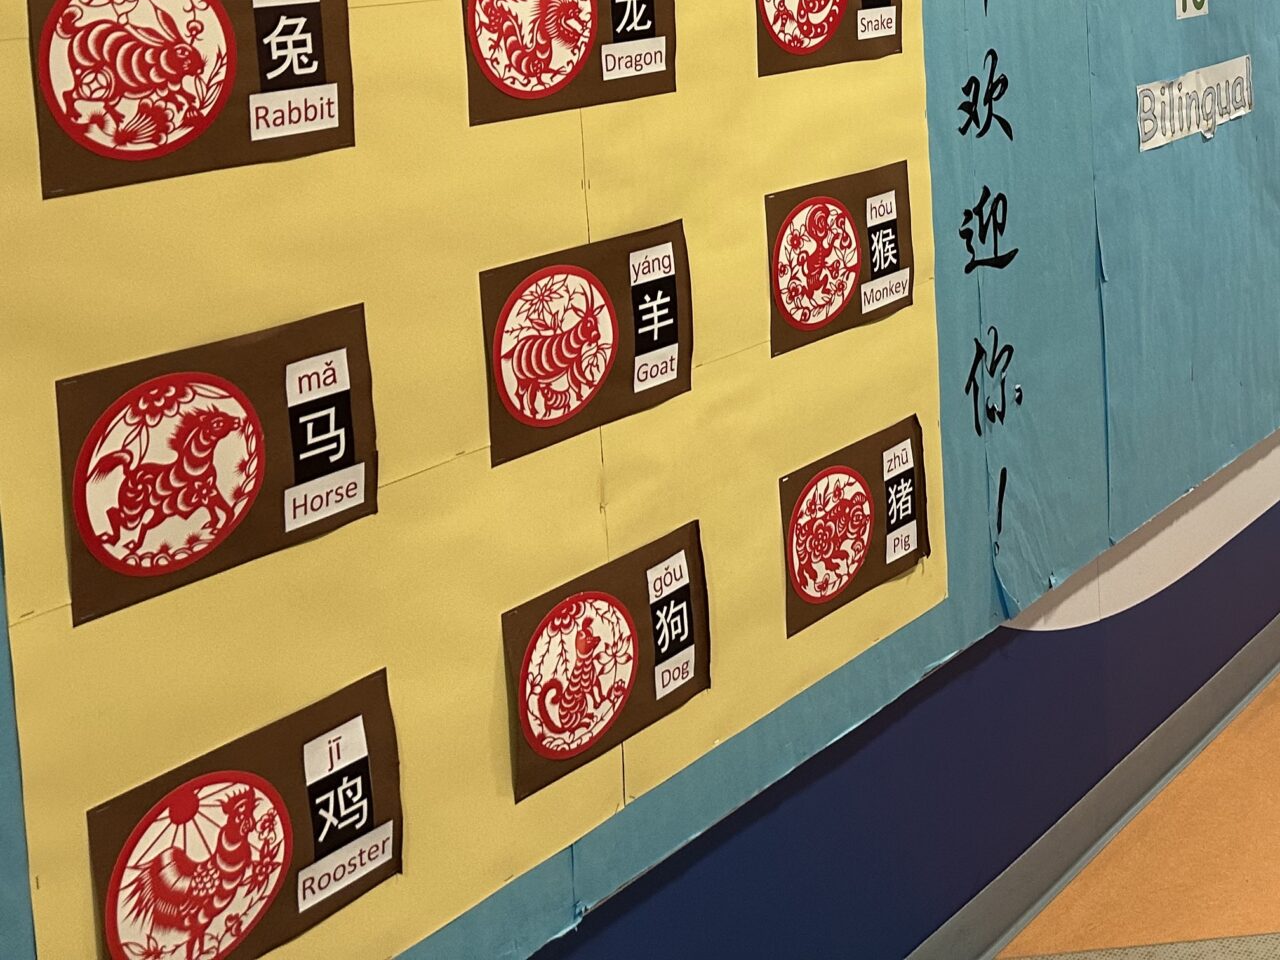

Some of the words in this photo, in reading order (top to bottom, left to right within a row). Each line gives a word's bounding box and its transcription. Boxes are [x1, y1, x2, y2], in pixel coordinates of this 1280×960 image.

[860, 14, 893, 33] Snake
[262, 15, 319, 80] 兔
[604, 49, 663, 72] Dragon
[254, 97, 336, 130] Rabbit
[1138, 56, 1253, 143] Bilingual
[870, 199, 893, 220] hóu
[632, 254, 672, 283] yáng
[871, 228, 898, 273] 猴
[863, 279, 908, 307] Monkey
[638, 289, 674, 341] 羊
[636, 355, 676, 383] Goat
[299, 406, 346, 463] 马
[886, 448, 909, 473] zhū
[292, 481, 359, 520] Horse
[888, 478, 913, 525] 猪
[893, 533, 911, 554] Pig
[655, 600, 689, 654] 狗
[661, 659, 690, 689] Dog
[327, 736, 343, 772] jī
[315, 776, 368, 842] 鸡
[302, 836, 391, 901] Rooster
